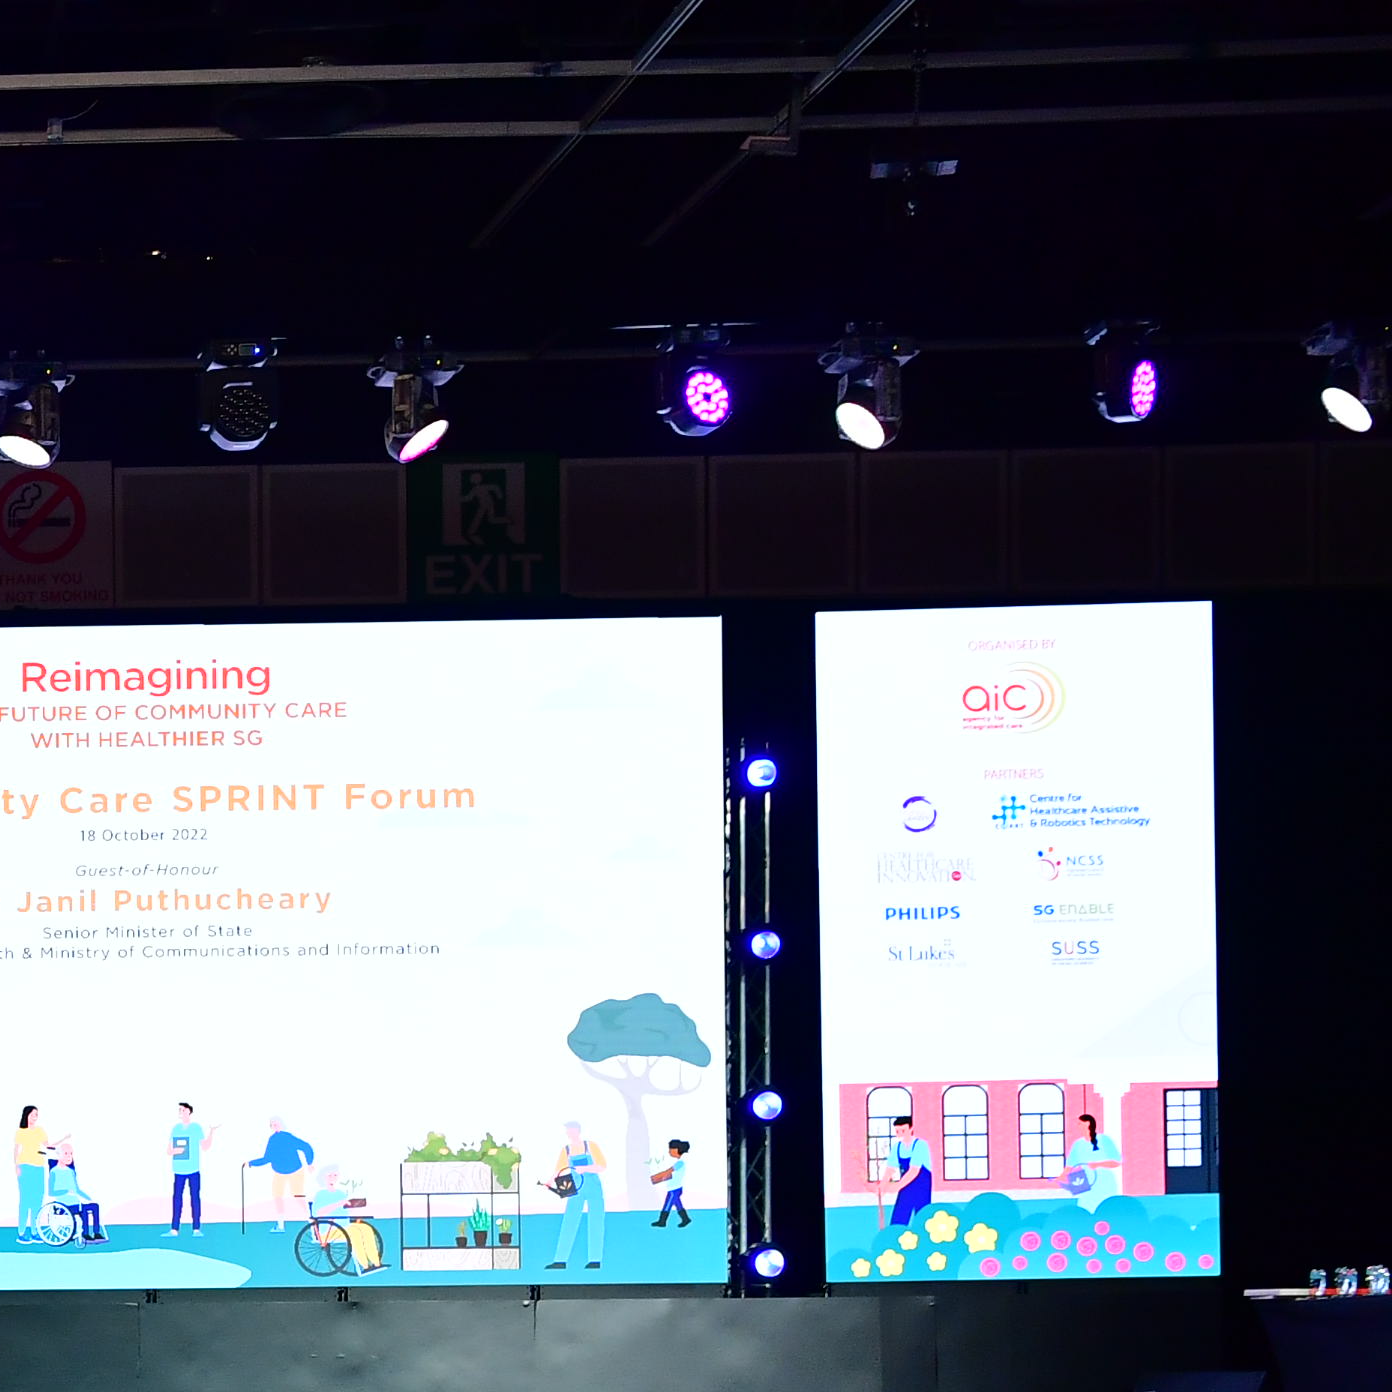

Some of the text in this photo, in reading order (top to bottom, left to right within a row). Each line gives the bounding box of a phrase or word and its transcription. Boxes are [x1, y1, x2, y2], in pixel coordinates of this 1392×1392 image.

[46, 572, 81, 585] YOU
[425, 552, 544, 595] EXIT
[968, 638, 1056, 652] ORGANISED BY
[19, 658, 272, 698] Reimagining
[962, 685, 1026, 712] aic
[95, 705, 127, 722] OF
[133, 702, 277, 721] COMMUNITY
[284, 701, 348, 720] CARE
[30, 729, 264, 750] WITH HEALTHIER SG
[984, 768, 1044, 780] PARTNERS
[58, 786, 155, 816] Care
[172, 783, 325, 813] SPRINT
[344, 782, 477, 810] Forum
[1029, 793, 1082, 804] Centre for
[1029, 804, 1140, 815] Healthcare Assistive
[1041, 817, 1086, 827] Robotics
[1089, 816, 1151, 827] Technology
[79, 827, 209, 843] 18 October 2022
[1066, 855, 1104, 867] NCSS
[74, 862, 219, 879] Guest-of-Honour
[16, 889, 97, 914] Janil
[113, 886, 332, 915] Puthucheary
[885, 905, 961, 921] PHILIPS
[1033, 904, 1055, 916] SG
[42, 923, 253, 940] Senior Minister of State
[21, 945, 34, 961] &
[39, 945, 111, 962] Ministry
[117, 944, 136, 959] of
[141, 943, 290, 960] Communications
[296, 942, 330, 958] and
[337, 941, 441, 957] Information
[888, 946, 903, 962] St
[1051, 940, 1100, 956] SUSS
